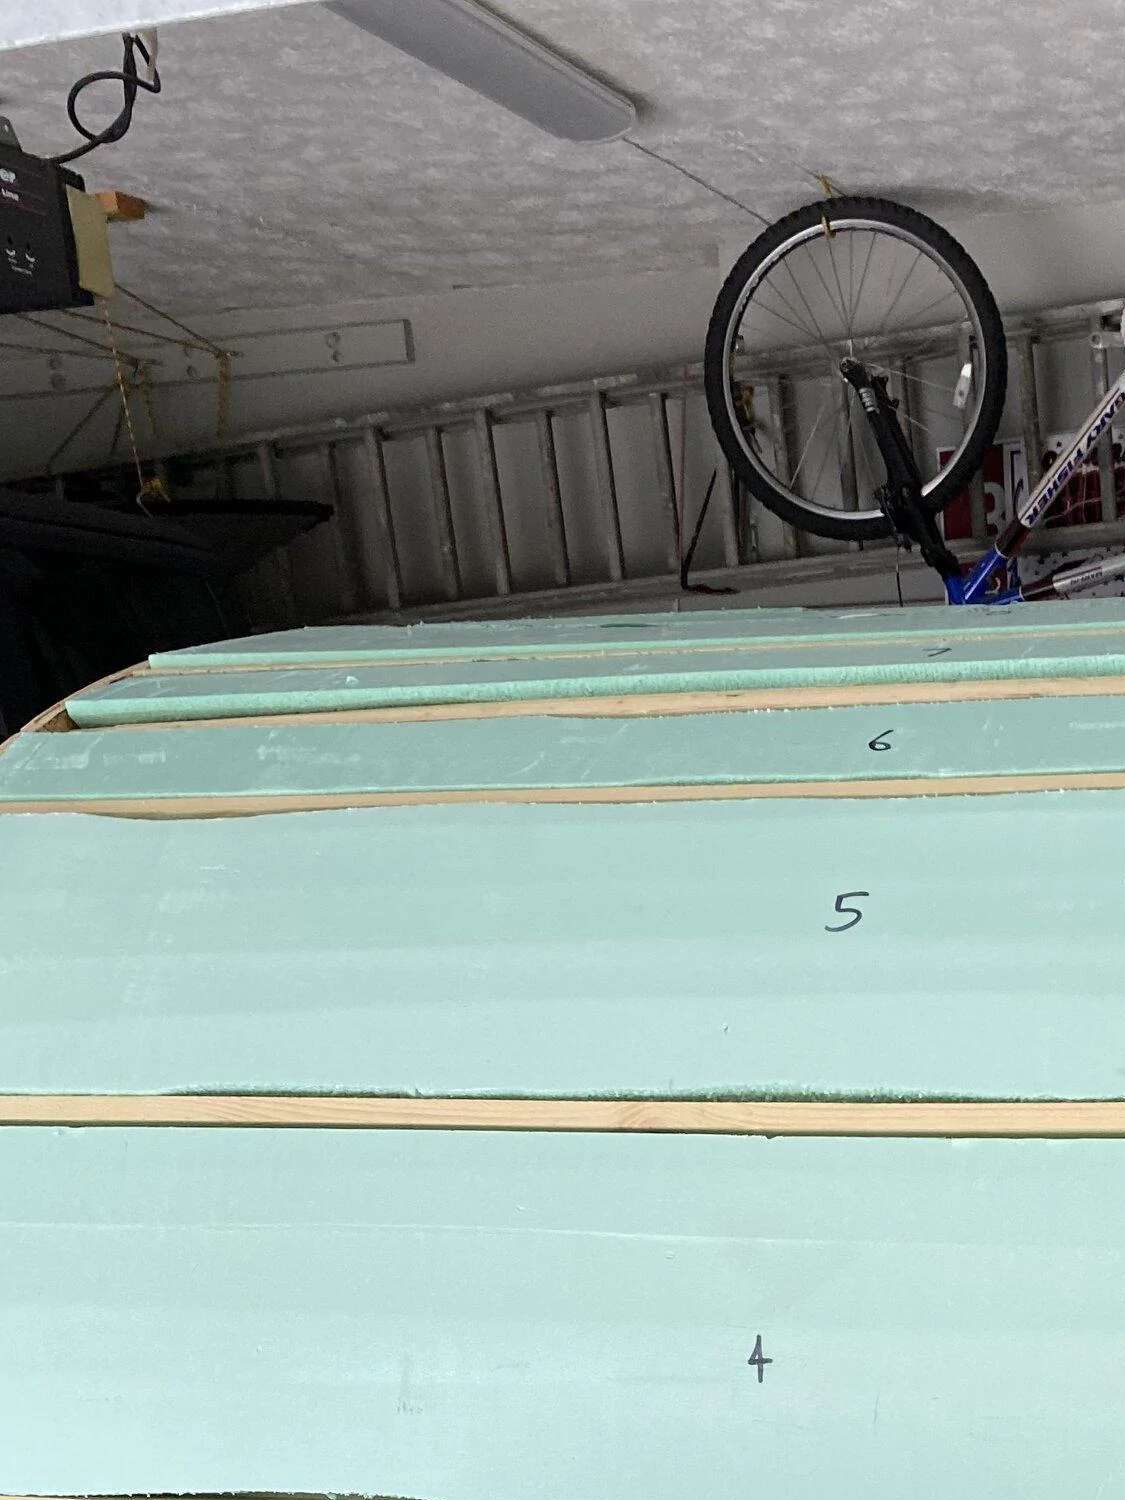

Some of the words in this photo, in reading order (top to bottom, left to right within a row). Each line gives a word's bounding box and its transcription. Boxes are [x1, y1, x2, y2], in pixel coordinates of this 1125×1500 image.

[1027, 448, 1085, 525] FISHER
[868, 729, 894, 752] 6
[824, 891, 870, 933] 5
[747, 1334, 774, 1384] 4
